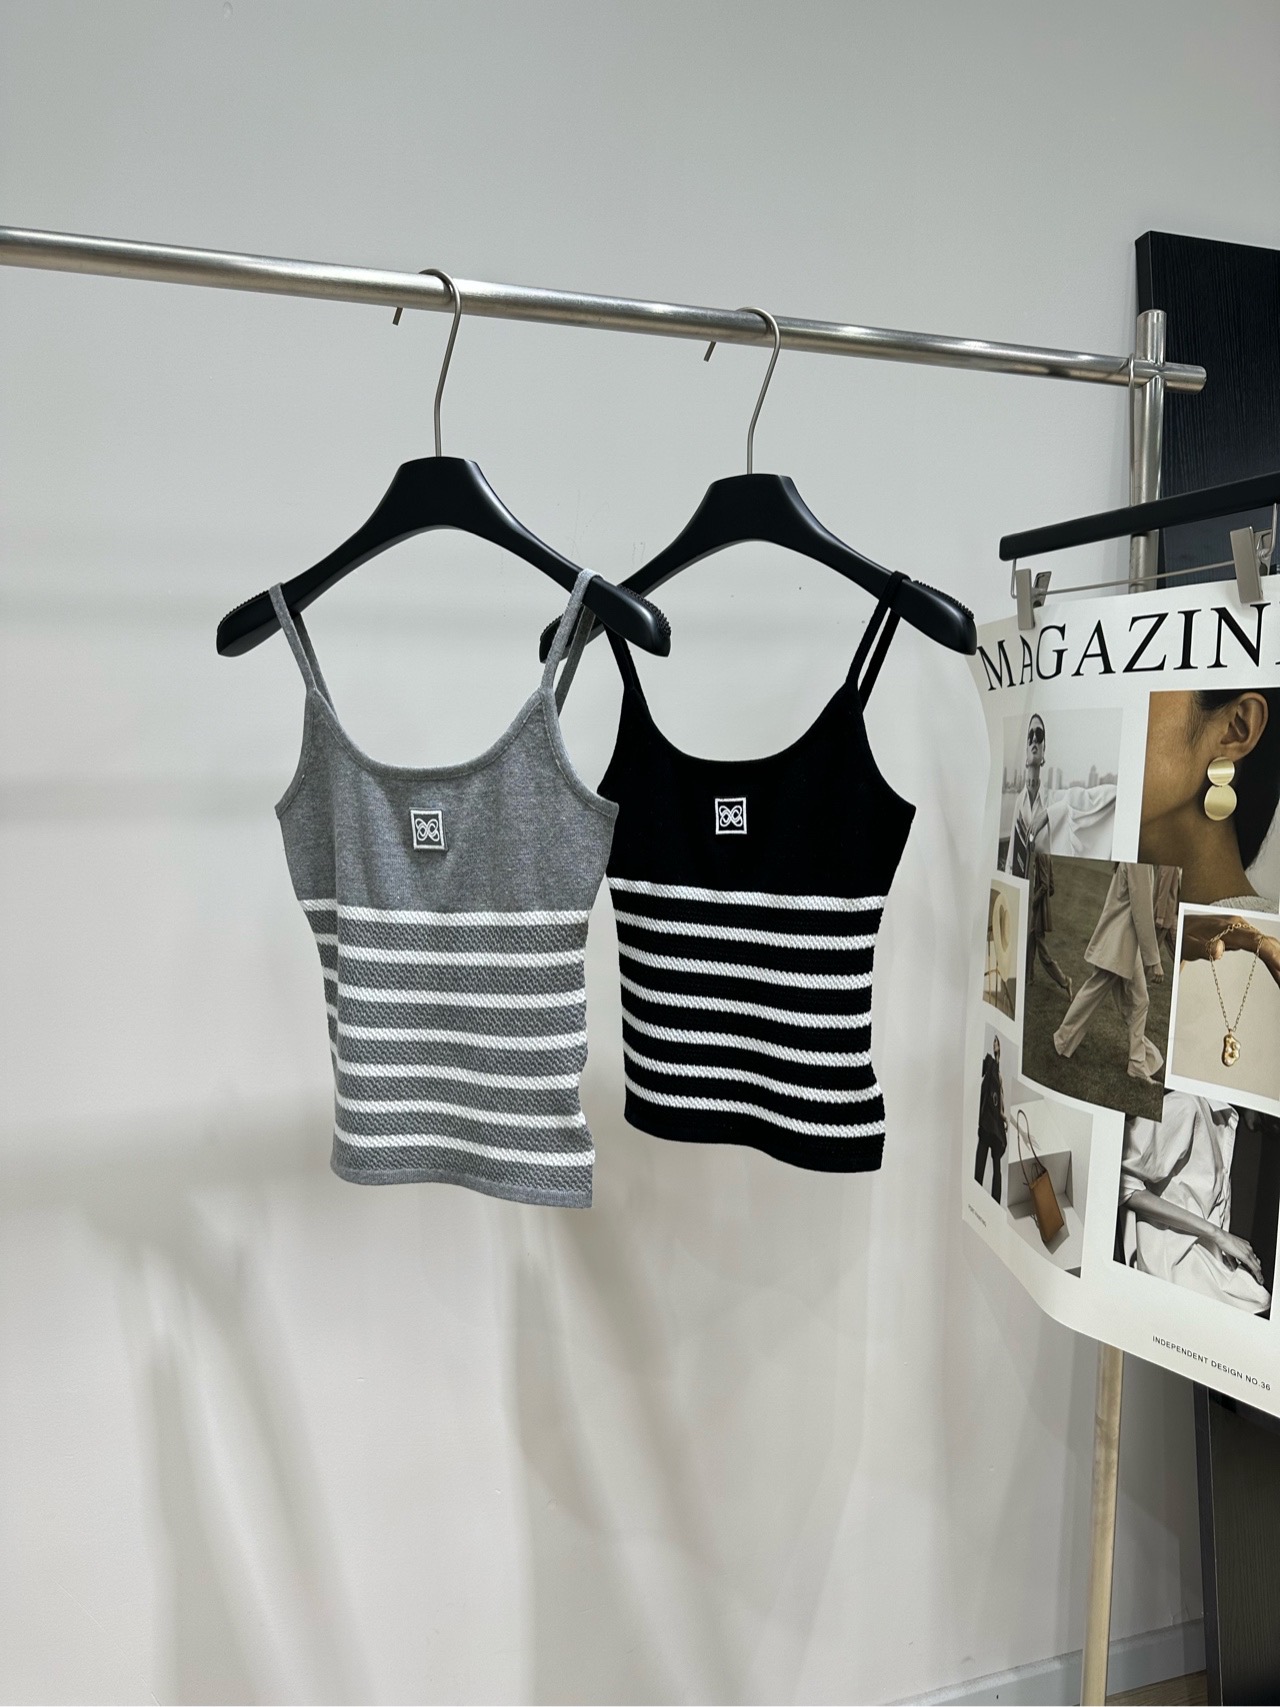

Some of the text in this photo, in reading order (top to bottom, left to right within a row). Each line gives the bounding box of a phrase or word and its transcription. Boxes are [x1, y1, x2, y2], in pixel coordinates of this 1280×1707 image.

[977, 602, 1280, 691] MAGAZIN
[1152, 1335, 1271, 1391] INDEPENDENT DESIGN NO.36
